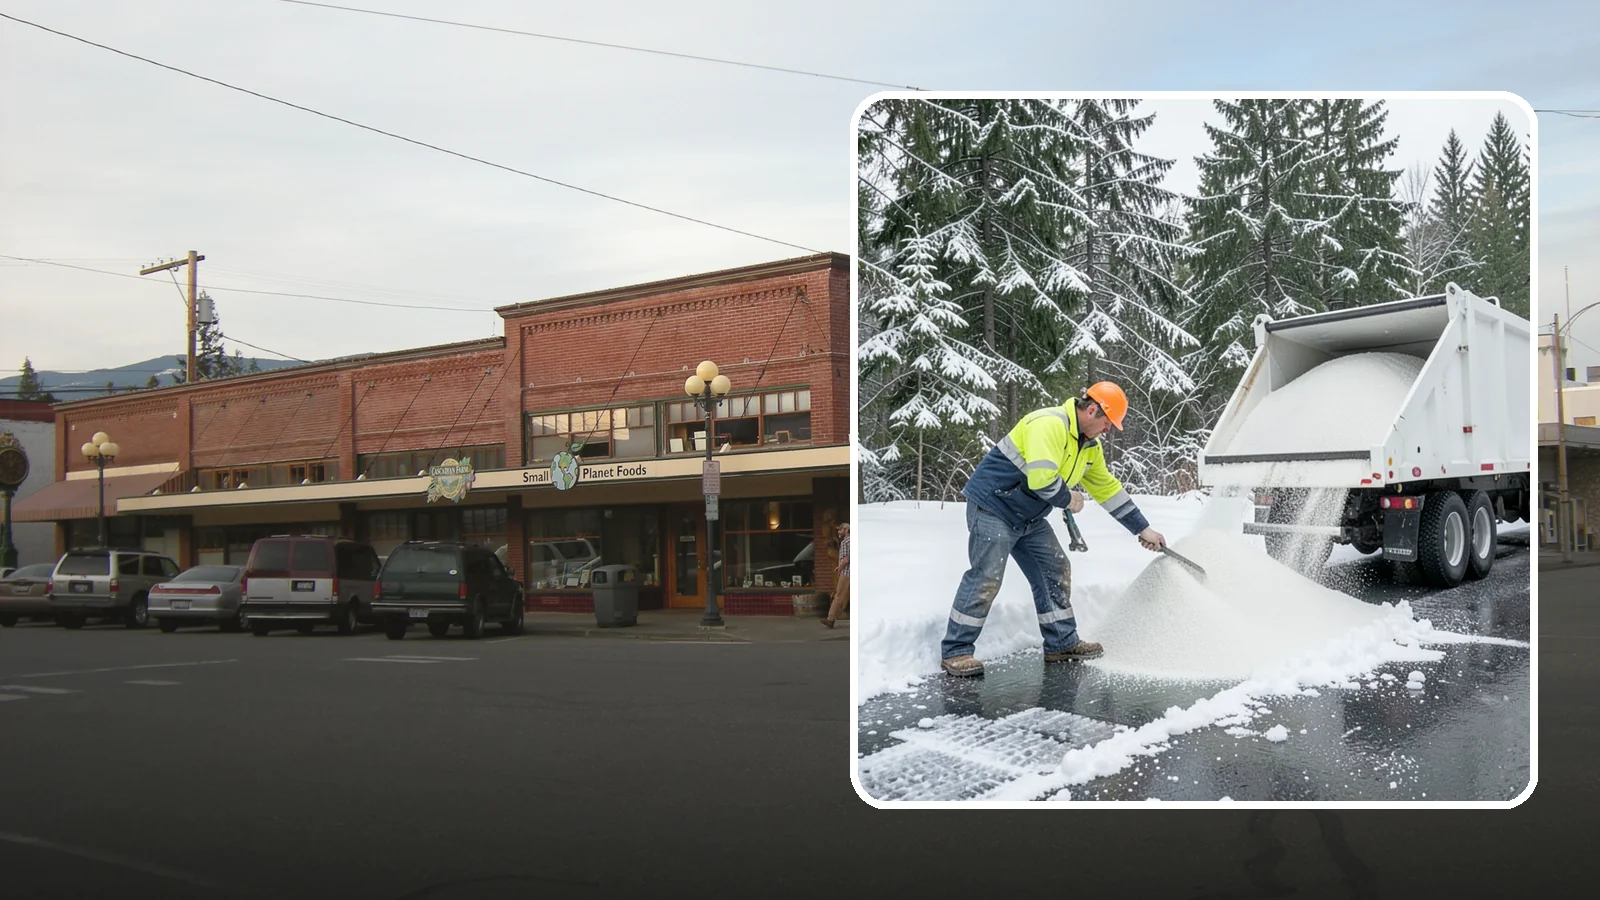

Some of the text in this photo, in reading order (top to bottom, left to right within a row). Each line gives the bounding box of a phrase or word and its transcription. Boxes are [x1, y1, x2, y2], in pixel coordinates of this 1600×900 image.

[523, 464, 647, 483] Small Planet Foods
